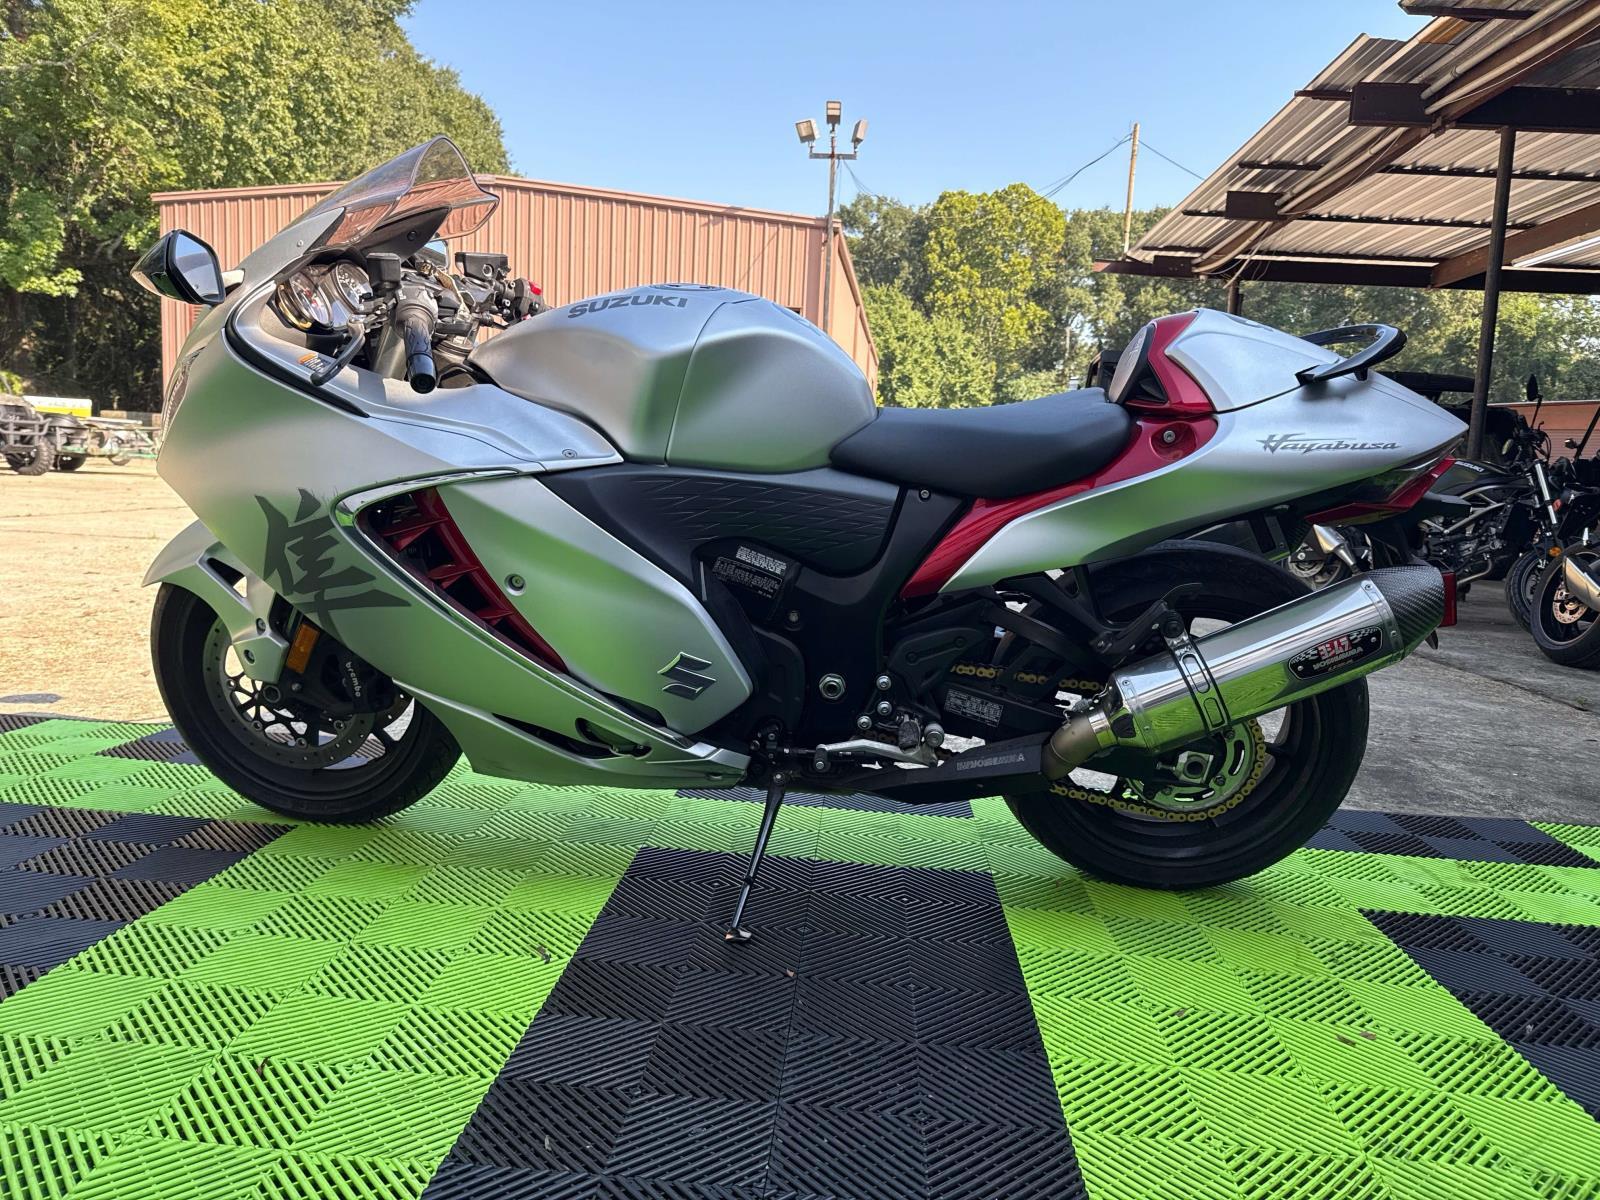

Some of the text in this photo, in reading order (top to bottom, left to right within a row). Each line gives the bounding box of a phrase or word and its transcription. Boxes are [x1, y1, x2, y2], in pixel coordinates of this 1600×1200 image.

[568, 294, 688, 318] SUZUKI
[1256, 432, 1400, 454] Hayabusa
[345, 661, 362, 698] brembo
